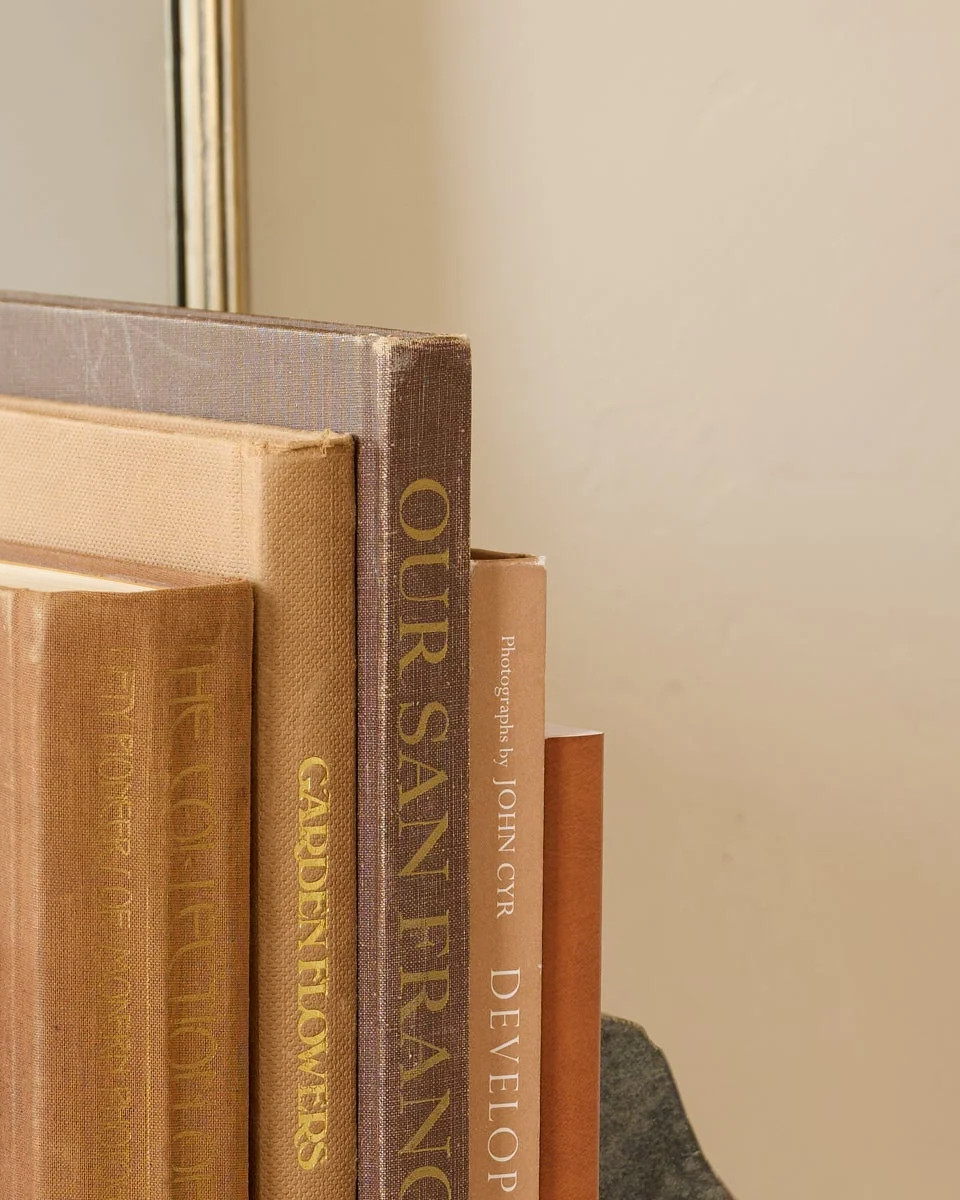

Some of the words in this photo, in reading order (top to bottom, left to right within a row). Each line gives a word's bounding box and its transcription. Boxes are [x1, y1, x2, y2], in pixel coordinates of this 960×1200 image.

[399, 478, 450, 680] OUR
[493, 748, 514, 768] by
[495, 636, 515, 744] Photographs
[294, 757, 330, 950] GARDEN
[398, 701, 450, 881] SAN
[493, 777, 516, 852] JOHN
[496, 863, 515, 919] CYR
[294, 958, 328, 1170] FLOWERS
